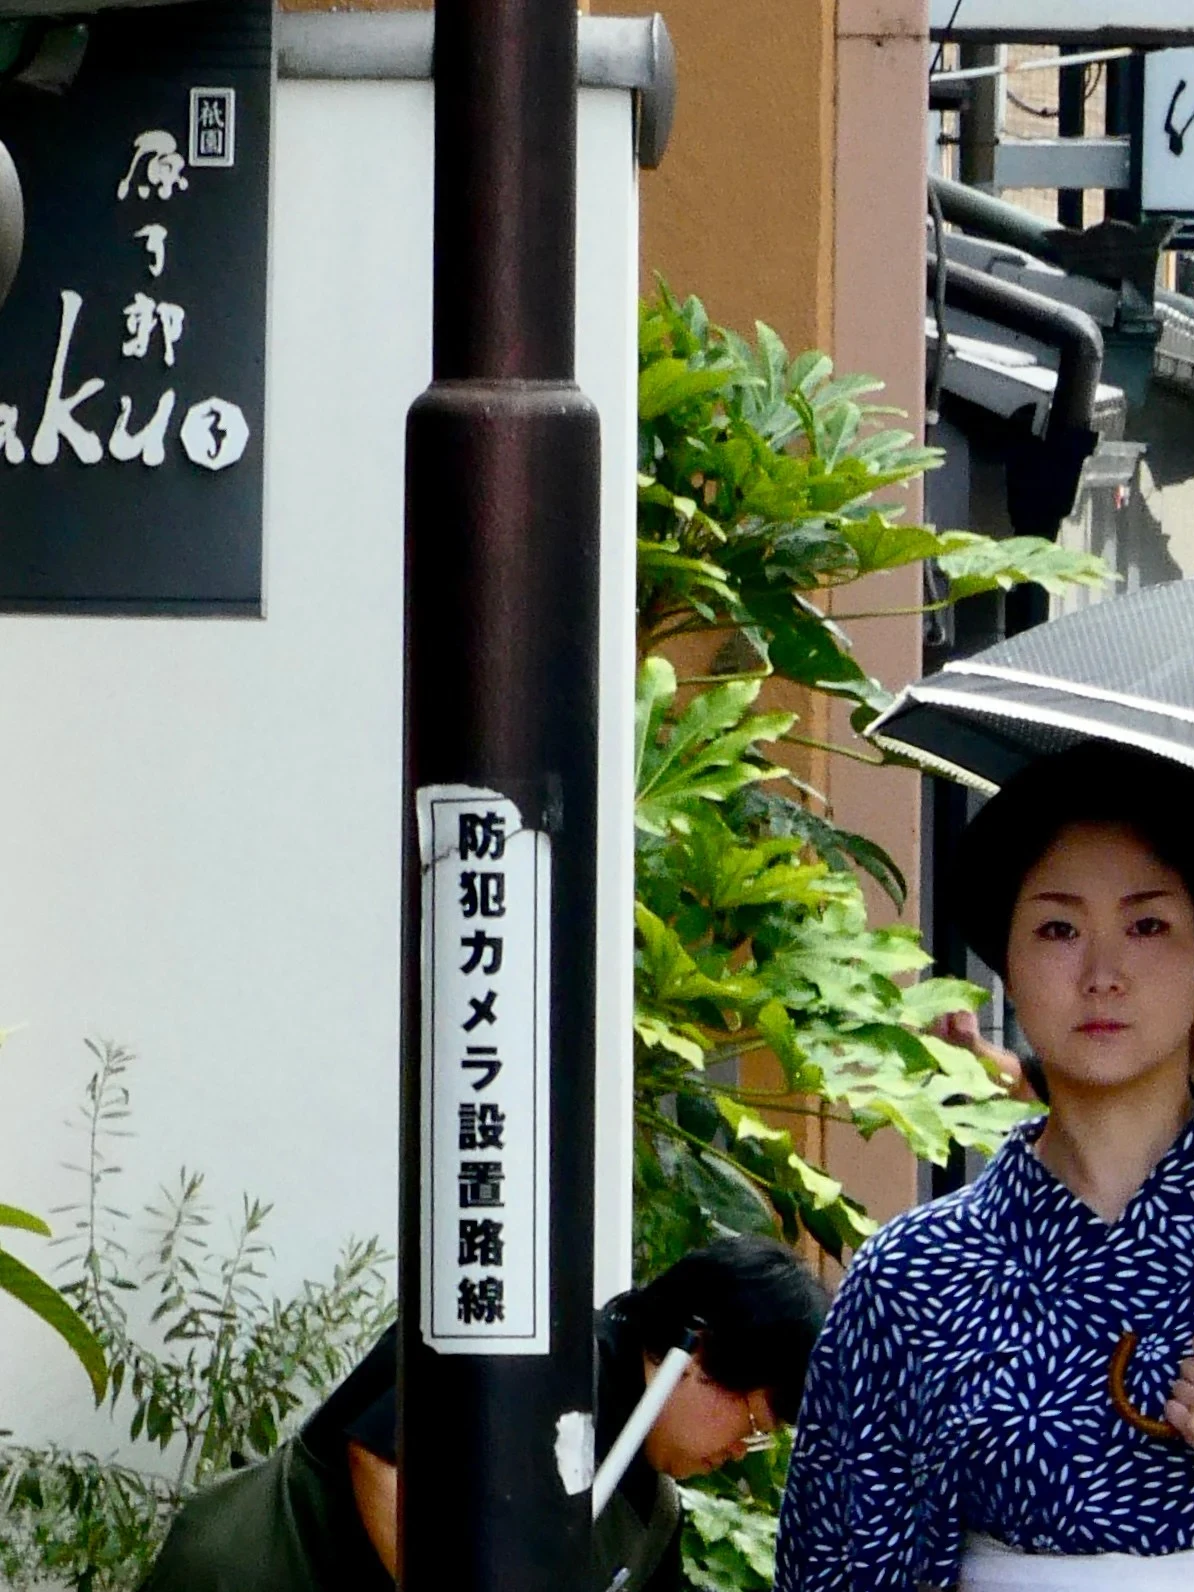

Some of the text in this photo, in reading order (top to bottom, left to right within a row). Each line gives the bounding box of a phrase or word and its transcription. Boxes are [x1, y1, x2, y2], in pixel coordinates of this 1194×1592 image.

[457, 812, 506, 1324] 防犯カメラ設置路線
